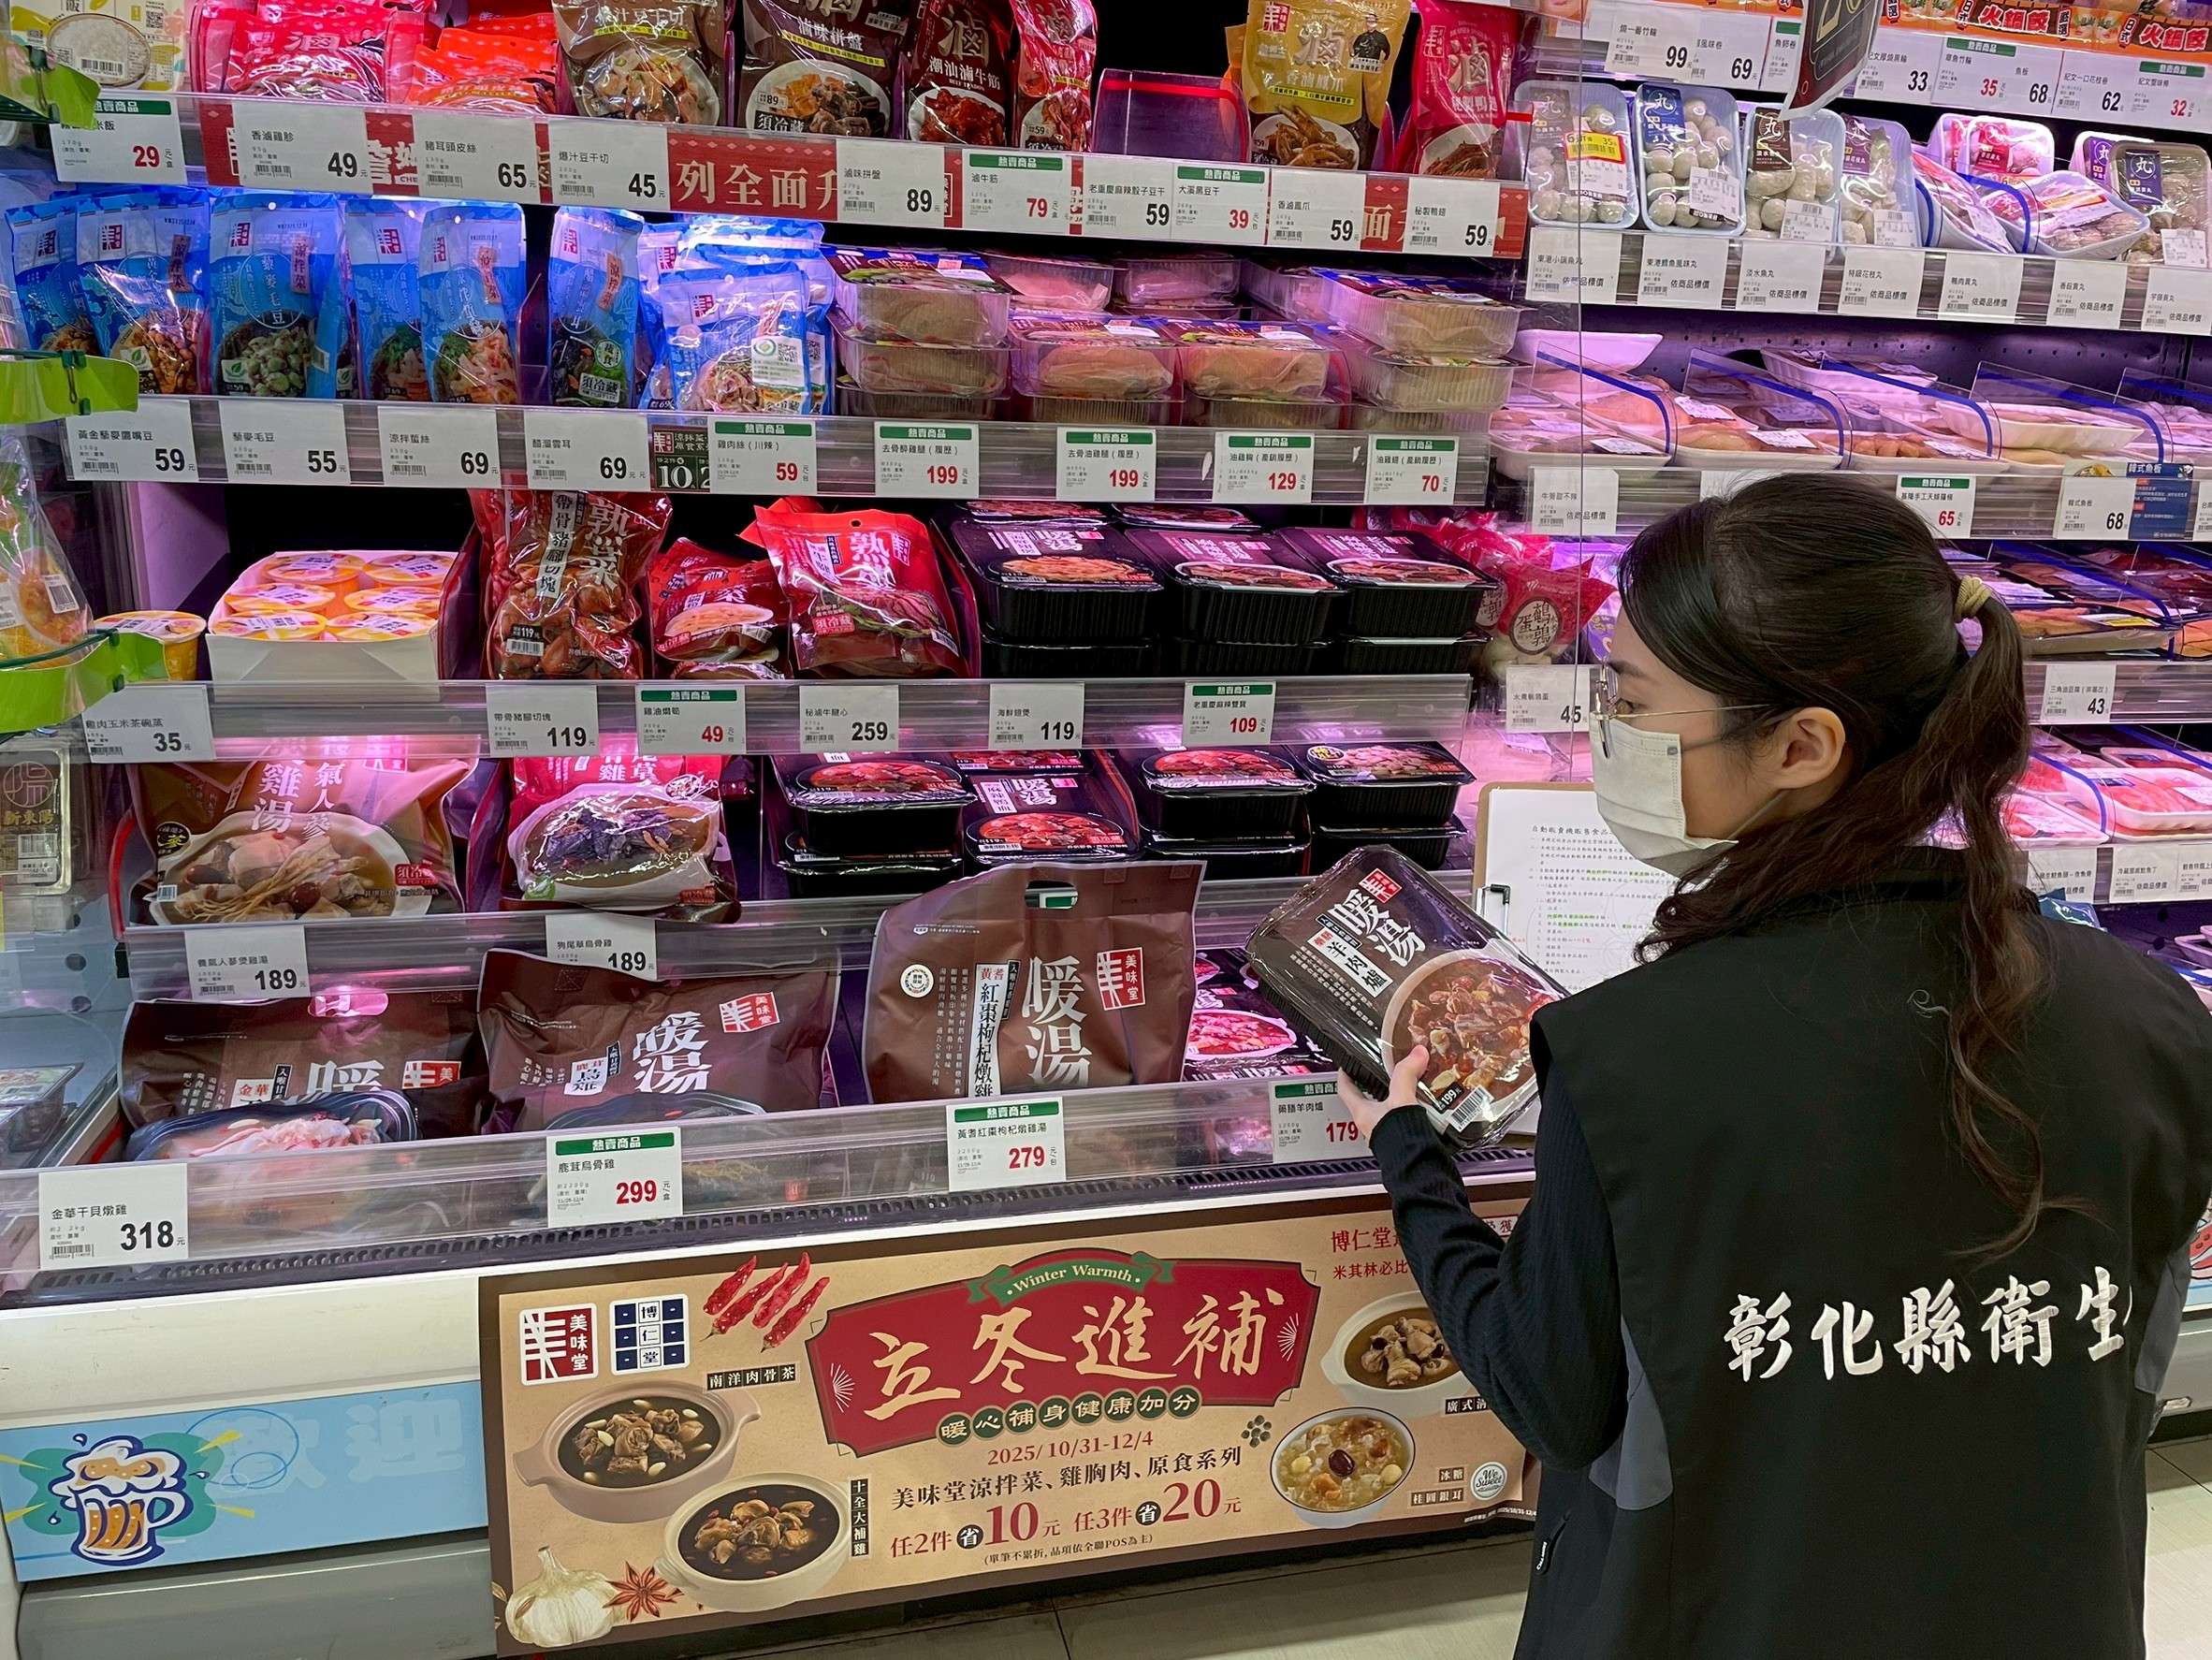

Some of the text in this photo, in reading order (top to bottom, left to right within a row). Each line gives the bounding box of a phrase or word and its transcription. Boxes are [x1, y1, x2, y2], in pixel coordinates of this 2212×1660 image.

[1978, 5, 2050, 34] 火鍋餃
[797, 16, 864, 51] 滷味拼盤
[2139, 23, 2209, 51] 火鍋餃
[1968, 40, 1998, 52] 熱賣商品
[1666, 46, 1688, 68] 99
[1731, 57, 1753, 80] 69
[2015, 66, 2029, 76] 魚板
[1908, 70, 1928, 92] 33
[1980, 79, 1998, 96] 35
[1655, 94, 1673, 109] 丸
[2029, 83, 2048, 104] 68
[2102, 92, 2121, 111] 62
[1543, 97, 1561, 113] 丸
[2170, 99, 2188, 116] 32
[1764, 119, 1781, 137] 丸
[424, 139, 477, 153] 豬耳頭皮絲
[133, 145, 160, 167] 29
[327, 152, 357, 177] 49
[558, 150, 609, 165] 爆汁豆干切
[998, 155, 1037, 168] 熱賣商品
[497, 162, 527, 189] 65
[843, 167, 881, 181] 滷味拼盤
[1203, 168, 1241, 182] 熱賣商品
[2135, 160, 2153, 175] 丸
[628, 174, 656, 198] 45
[971, 172, 998, 184] 滷牛筋
[906, 189, 933, 213] 89
[1026, 197, 1048, 218] 79
[1145, 203, 1171, 226] 59
[1229, 209, 1249, 229] 39
[1414, 205, 1447, 217] 秘製鴨翅
[1330, 219, 1353, 240] 59
[1464, 224, 1487, 246] 59
[1562, 276, 1604, 287] 依商品標價
[1746, 268, 1775, 278] 淡水魚丸
[1670, 279, 1710, 289] 依商品標價
[1768, 289, 1808, 299] 依商品標價
[1870, 291, 1907, 300] 依商品標價
[1972, 297, 2008, 308] 依商品標價
[2079, 301, 2114, 312] 依商品標價
[2169, 313, 2203, 323] 依商品標價
[582, 375, 618, 394] 須冷藏
[232, 431, 275, 443] 藜麥毛豆
[745, 424, 785, 435] 熱賣商品
[908, 428, 946, 439] 熱賣商品
[1093, 433, 1128, 443] 熱賣商品
[717, 439, 780, 451] 雞肉絲（川辣）
[881, 444, 959, 457] 去骨醉雞腿（履歷）
[1254, 436, 1289, 447] 熱賣商品
[1400, 439, 1433, 450] 熱賣商品
[154, 448, 185, 472] 59
[307, 450, 337, 473] 55
[460, 452, 488, 474] 69
[1067, 449, 1141, 459] 去骨油雞腿（履歷）
[600, 457, 627, 479] 69
[659, 465, 692, 488] 10
[776, 462, 798, 481] 59
[926, 465, 958, 485] 199
[2128, 462, 2162, 473] 韓式魚板
[1109, 469, 1139, 488] 199
[1268, 473, 1297, 490] 129
[1421, 474, 1440, 492] 70
[1921, 478, 1951, 488] 熱賣商品
[2068, 499, 2093, 507] 韓式魚板
[1938, 510, 1956, 526] 65
[2106, 512, 2124, 531] 68
[670, 691, 710, 701] 熱賣商品
[1216, 685, 1250, 695] 熱賣商品
[1560, 706, 1582, 723] 45
[2088, 698, 2105, 714] 43
[85, 719, 164, 730] 雞肉玉米茶碗蒸
[851, 721, 888, 741] 259
[1040, 721, 1074, 741] 119
[1230, 717, 1257, 734] 109
[153, 733, 182, 752] 35
[546, 727, 587, 748] 119
[701, 725, 723, 743] 49
[4, 810, 54, 825] 新東陽
[1532, 825, 1613, 836] 自動販賣機販售食品
[1327, 889, 1426, 968] 暖湯
[607, 952, 647, 971] 189
[254, 968, 298, 992] 189
[981, 968, 1005, 981] 黃耆
[1125, 954, 1139, 1002] 美味堂
[1021, 954, 1093, 1085] 暖湯
[633, 1011, 709, 1095] 暖湯
[239, 1083, 269, 1098] 金華
[1304, 1085, 1338, 1095] 熱賣商
[987, 1105, 1030, 1118] 熱賣商品
[1277, 1100, 1324, 1113] 藥膳羊肉爐
[957, 1123, 1047, 1140] 黃耆紅棗枸杞燉雞湯
[1326, 1121, 1359, 1143] 179
[558, 1158, 615, 1173] 鹿茸烏骨雞
[1009, 1146, 1045, 1169] 279
[616, 1179, 658, 1204] 299
[51, 1204, 127, 1220] 金華干貝燉雞
[120, 1220, 174, 1251] 318
[1013, 1263, 1133, 1293] Winter Warmth
[1723, 1265, 2132, 1382] 彰化縣衛生
[640, 1301, 661, 1365] 博仁堂
[569, 1313, 589, 1372] 美味堂
[864, 1288, 1285, 1422] 立冬進補
[708, 1366, 796, 1390] 南洋肉骨茶
[939, 1394, 1199, 1440] 暖心補身健康加分
[987, 1432, 1155, 1466] 2025/ 10/31-12/4
[891, 1446, 1244, 1511] 美味堂涼拌菜、雞胸肉、原食系列
[1440, 1469, 1463, 1480] 冰糖
[1413, 1489, 1463, 1504] 桂圓銀耳
[851, 1479, 868, 1556] 十全大補雞
[891, 1478, 1243, 1559] 任2件省10元 任3件省20元
